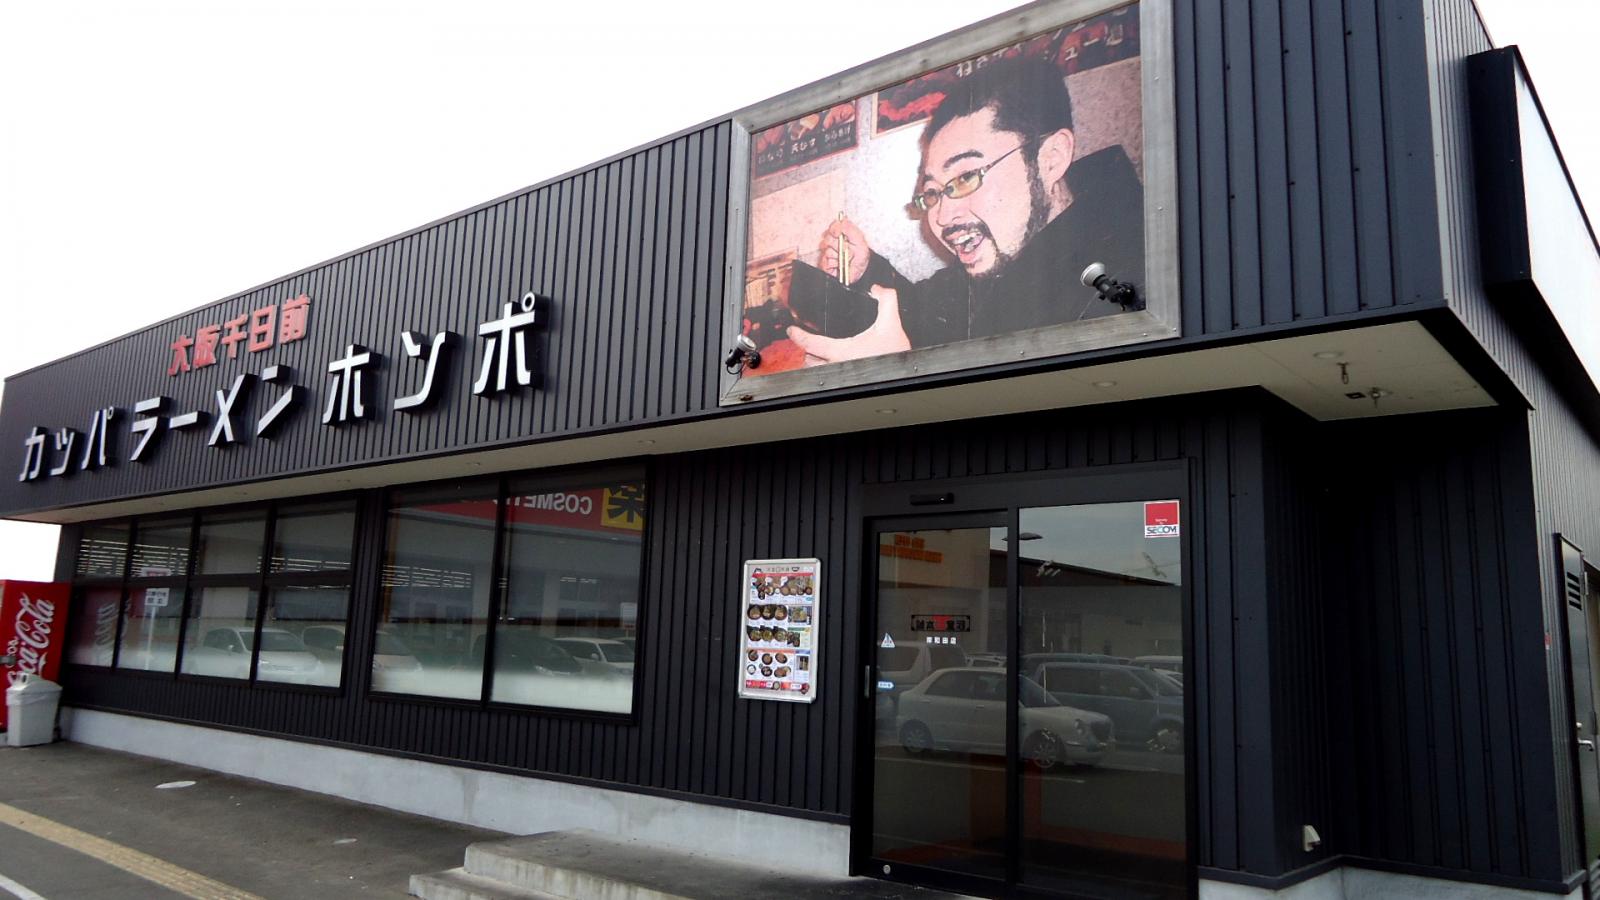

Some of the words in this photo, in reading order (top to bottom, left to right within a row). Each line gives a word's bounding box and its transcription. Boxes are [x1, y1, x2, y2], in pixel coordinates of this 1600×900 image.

[168, 293, 312, 377] 大阪千日前
[1147, 526, 1177, 534] SECOM
